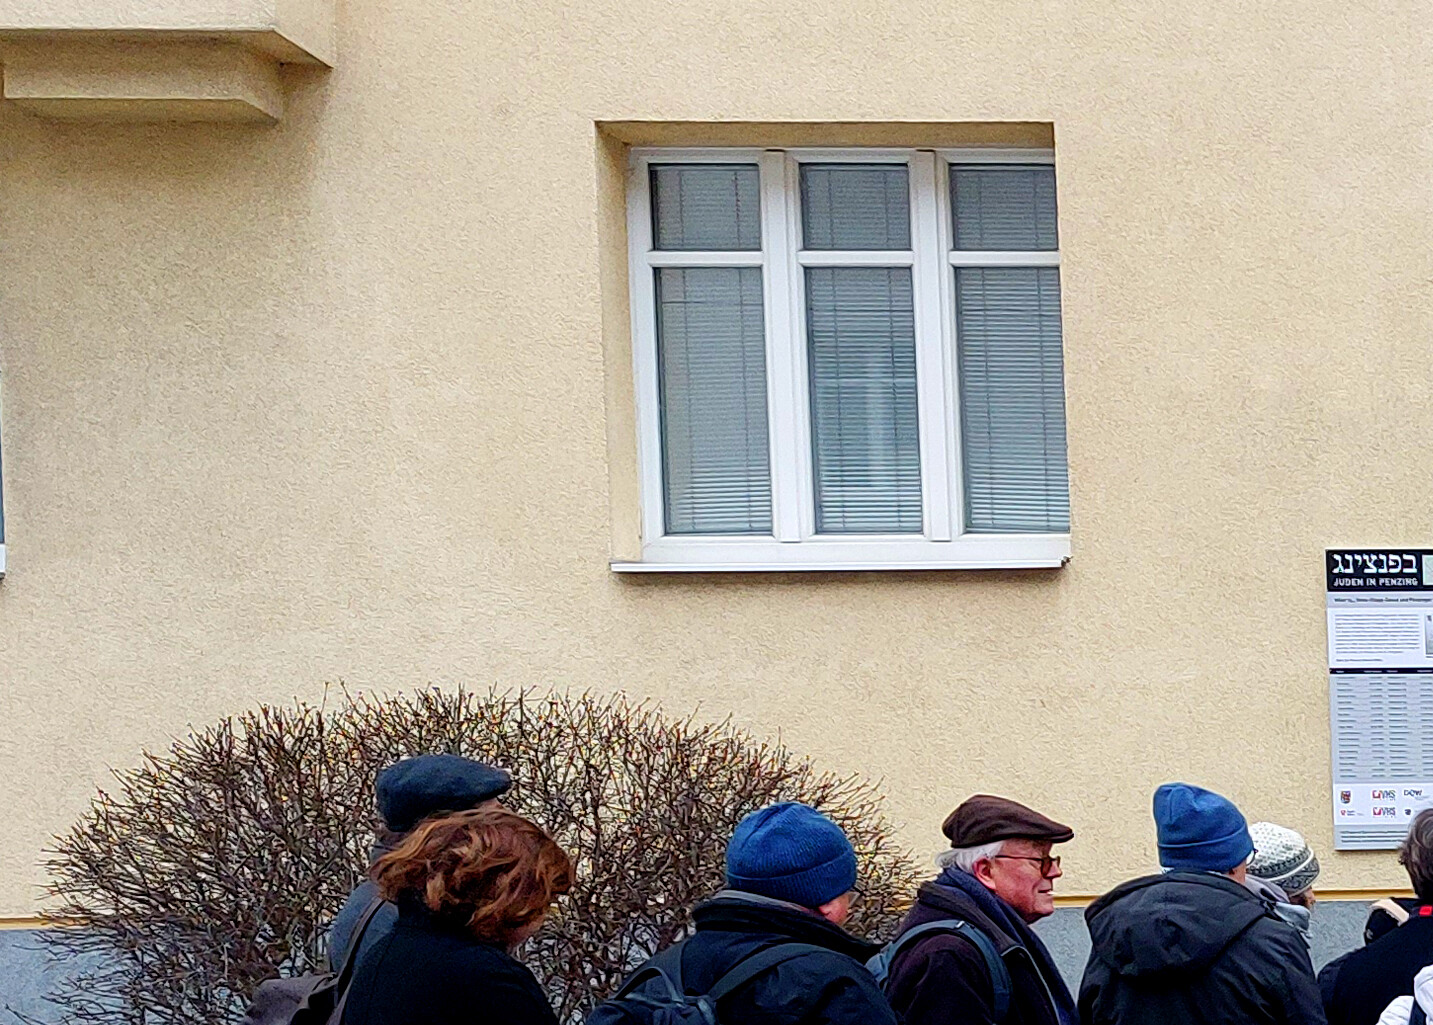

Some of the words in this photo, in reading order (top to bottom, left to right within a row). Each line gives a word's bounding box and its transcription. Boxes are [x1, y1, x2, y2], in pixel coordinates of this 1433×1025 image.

[1332, 553, 1418, 574] בפנצינג
[1333, 577, 1364, 587] JUDEN
[1366, 577, 1376, 587] IN
[1379, 577, 1418, 586] PENZING
